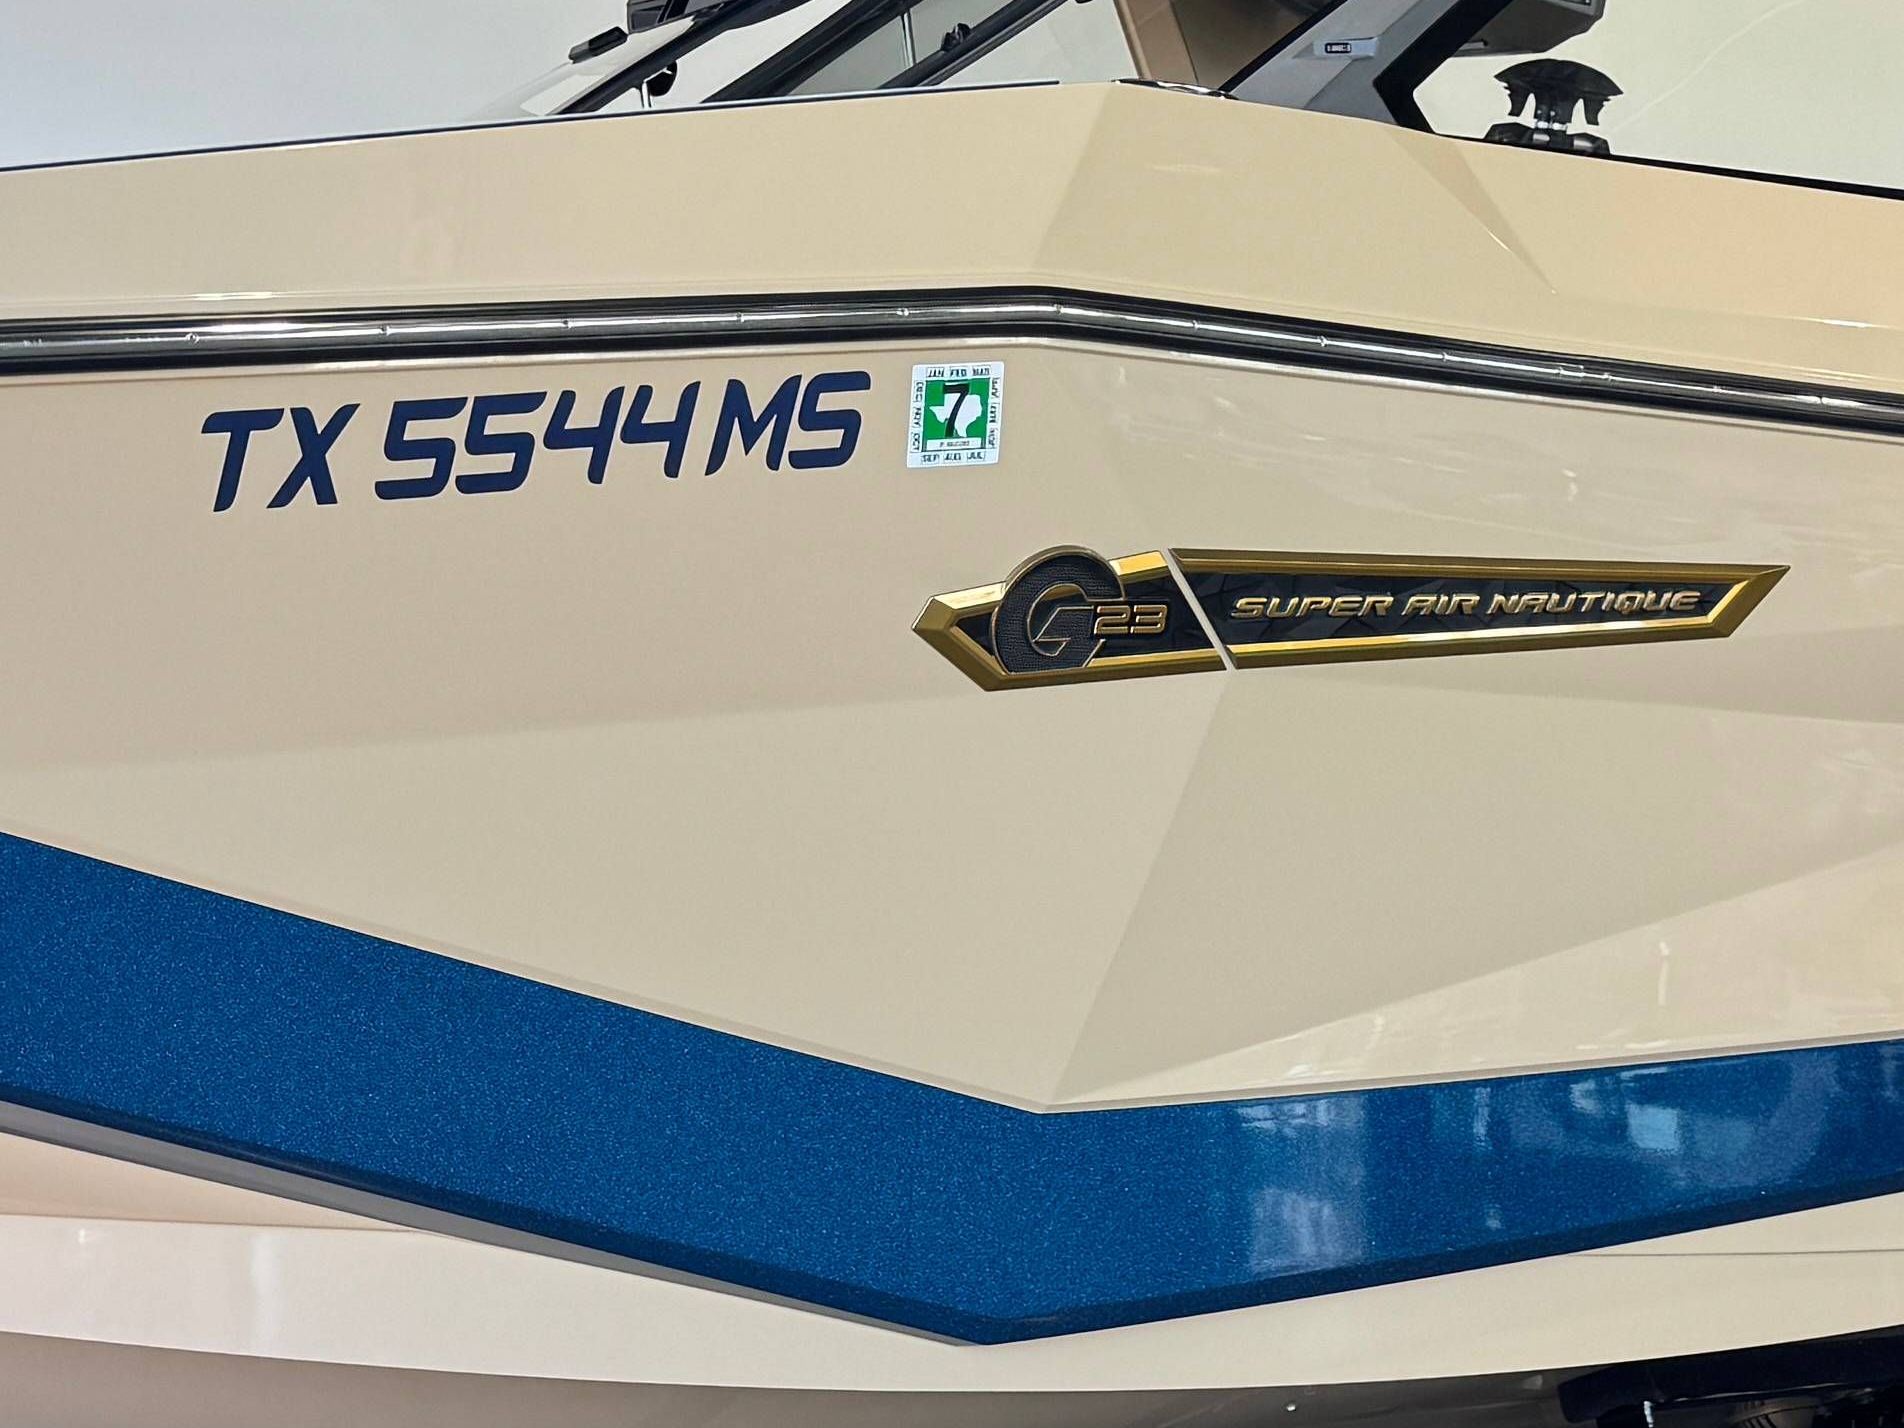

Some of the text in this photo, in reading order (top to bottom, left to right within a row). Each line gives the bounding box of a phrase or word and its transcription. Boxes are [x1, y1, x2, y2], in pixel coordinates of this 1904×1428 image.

[942, 382, 970, 438] 7
[201, 369, 871, 513] TX 5544 MS
[1231, 589, 1701, 620] SUPER AIR NAUTIQUE
